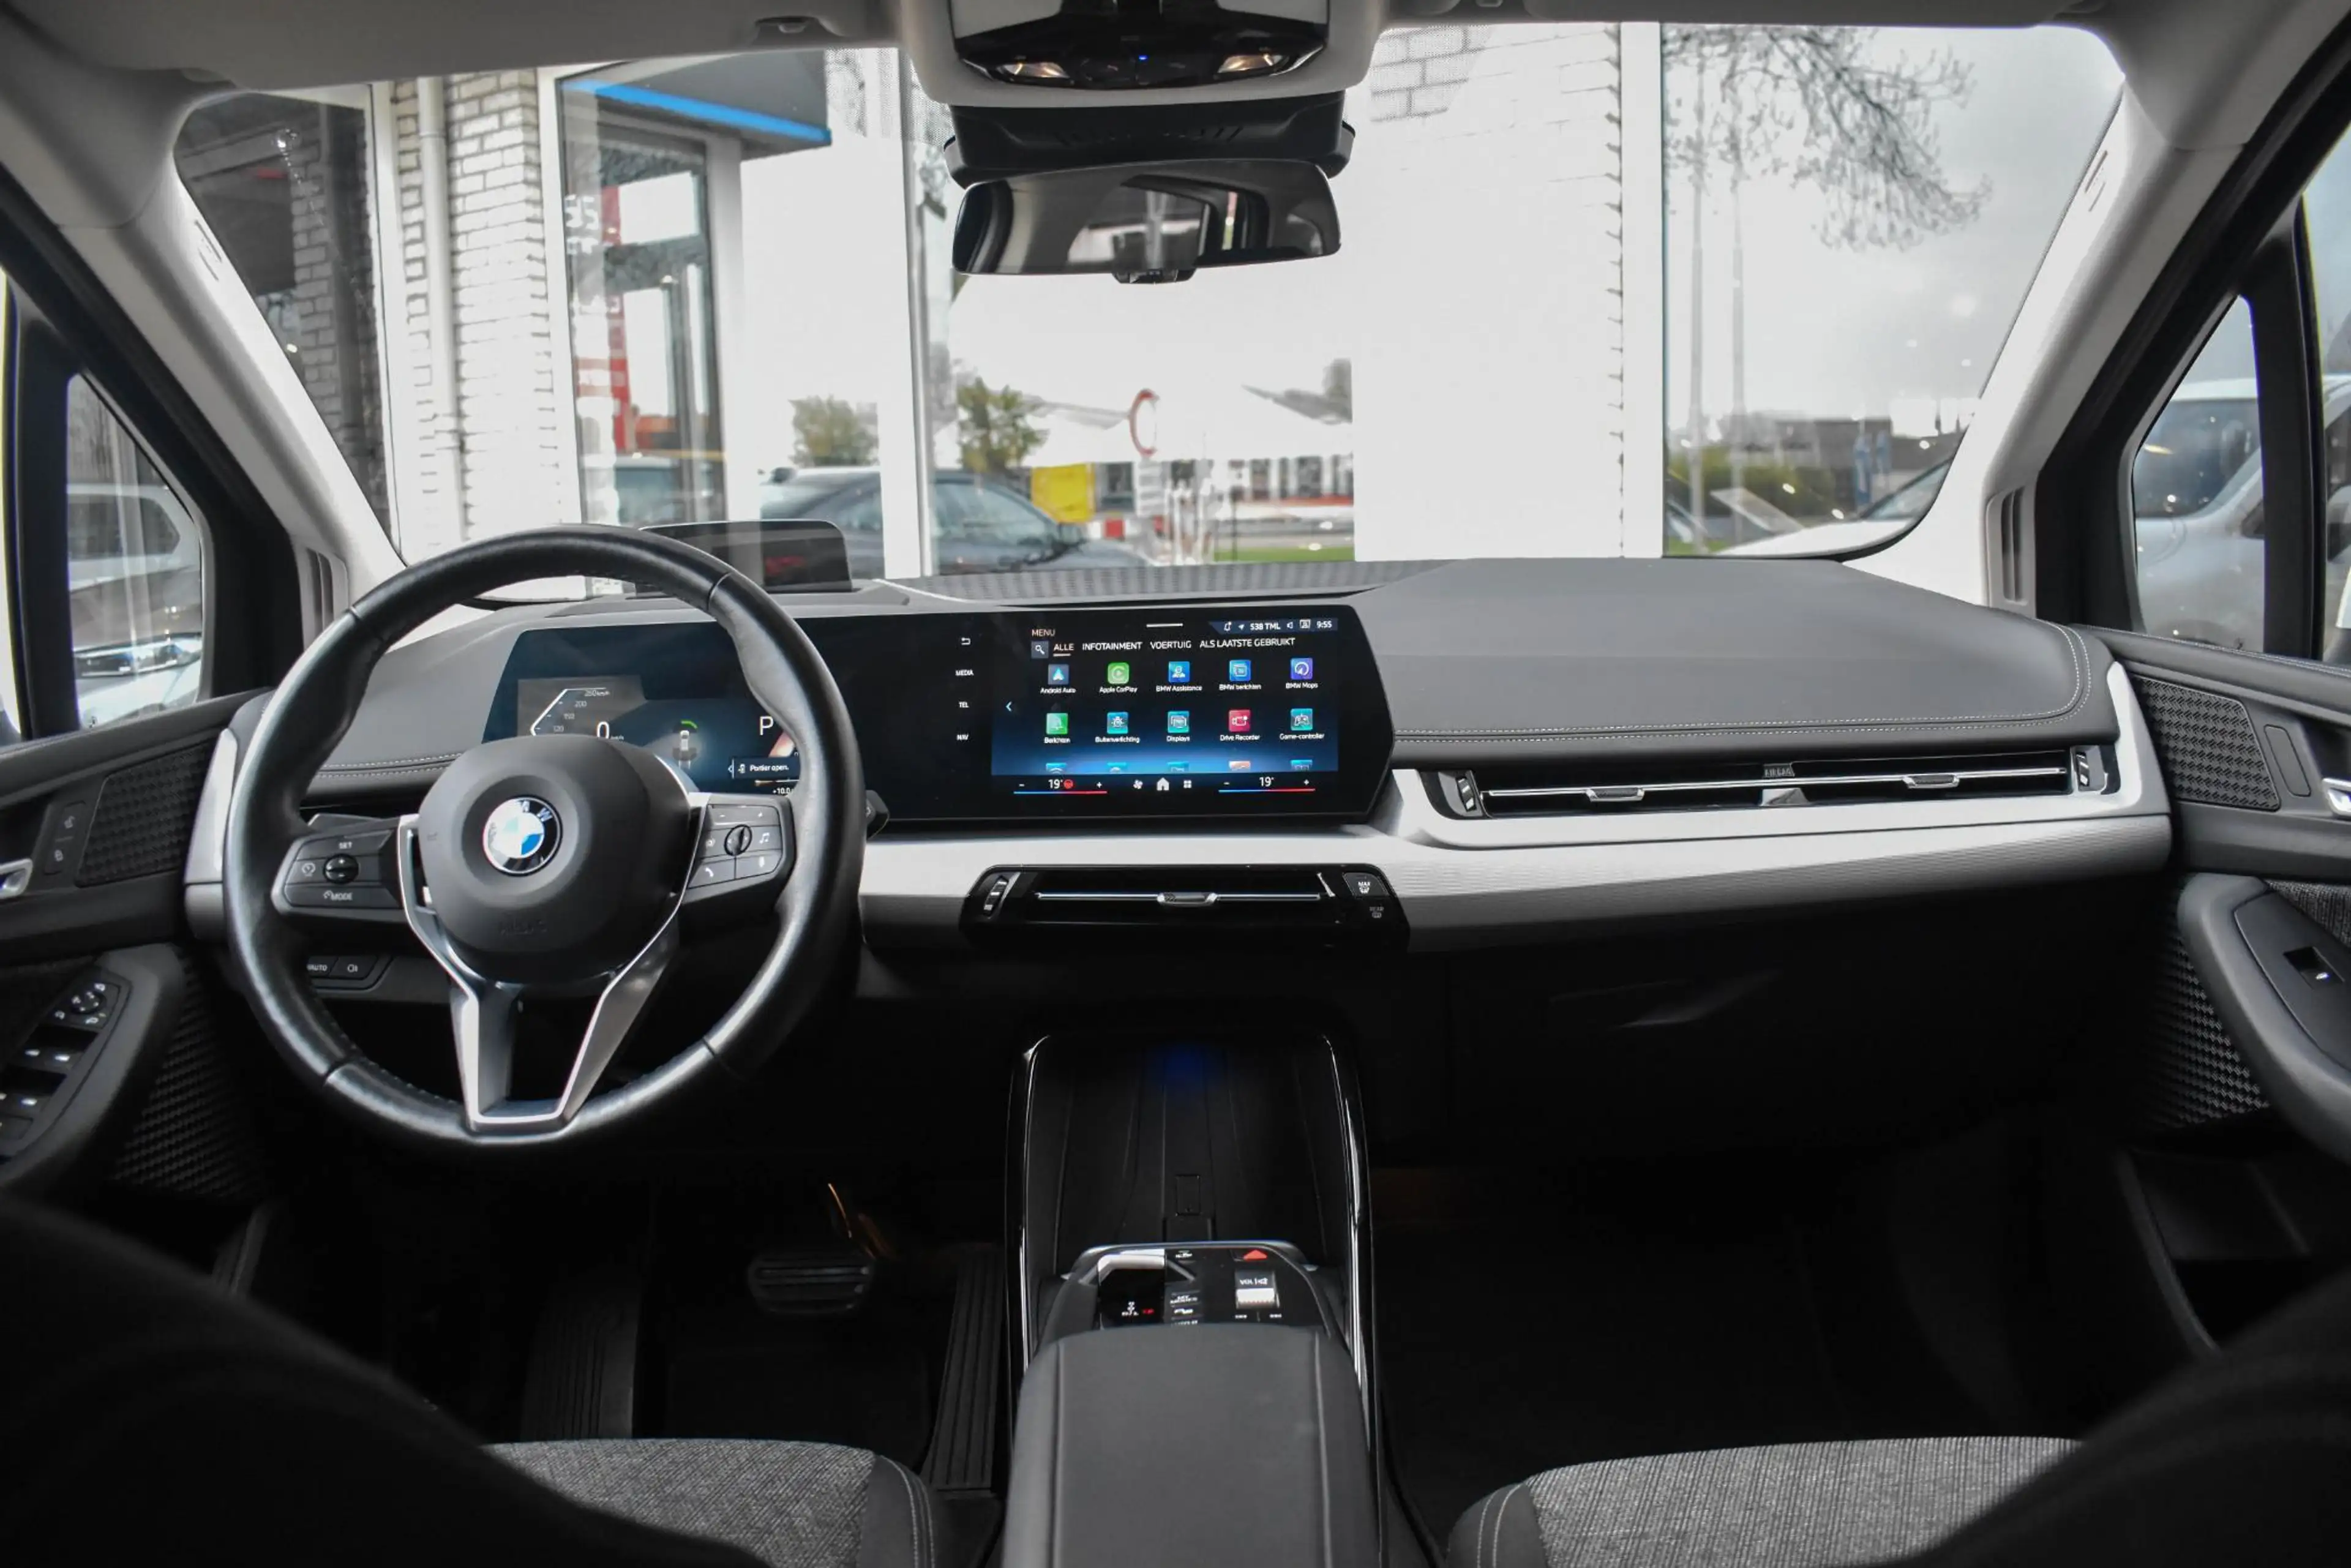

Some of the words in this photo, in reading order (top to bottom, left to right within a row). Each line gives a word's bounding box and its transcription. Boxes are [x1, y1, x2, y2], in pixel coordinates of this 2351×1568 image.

[1032, 628, 1055, 637] MENU
[1082, 642, 1142, 650] INFOTAINMENT
[1150, 640, 1191, 649] VOERTUIG
[1217, 639, 1252, 647] LAATSTE
[1253, 637, 1295, 647] GEBRUIKT
[596, 721, 610, 739] 0
[759, 715, 774, 736] P
[1280, 732, 1325, 741] Game-controller
[331, 891, 353, 901] MODE
